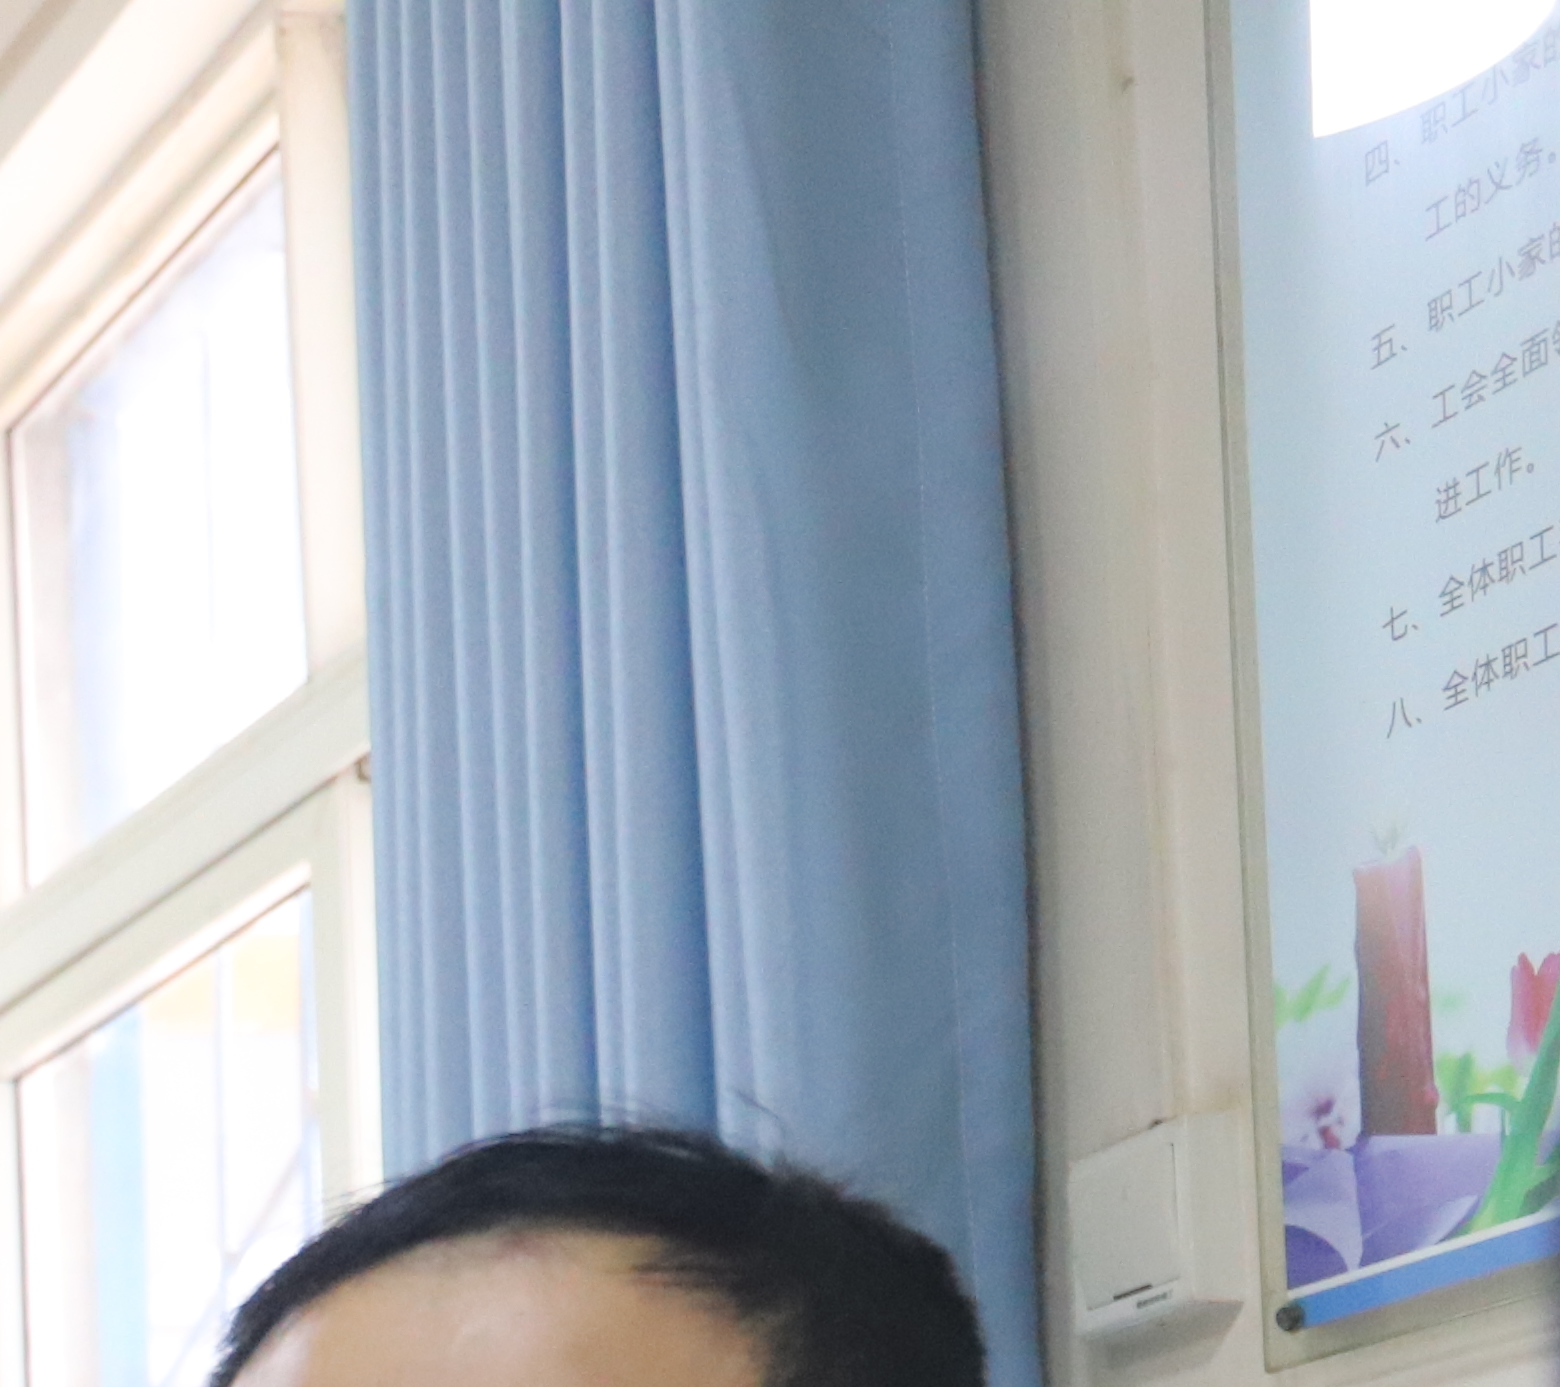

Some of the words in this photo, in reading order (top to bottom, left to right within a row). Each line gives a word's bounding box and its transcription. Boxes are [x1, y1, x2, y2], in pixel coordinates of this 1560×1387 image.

[1373, 319, 1560, 463] 六、工会全面
[1435, 446, 1535, 523] 进工作。
